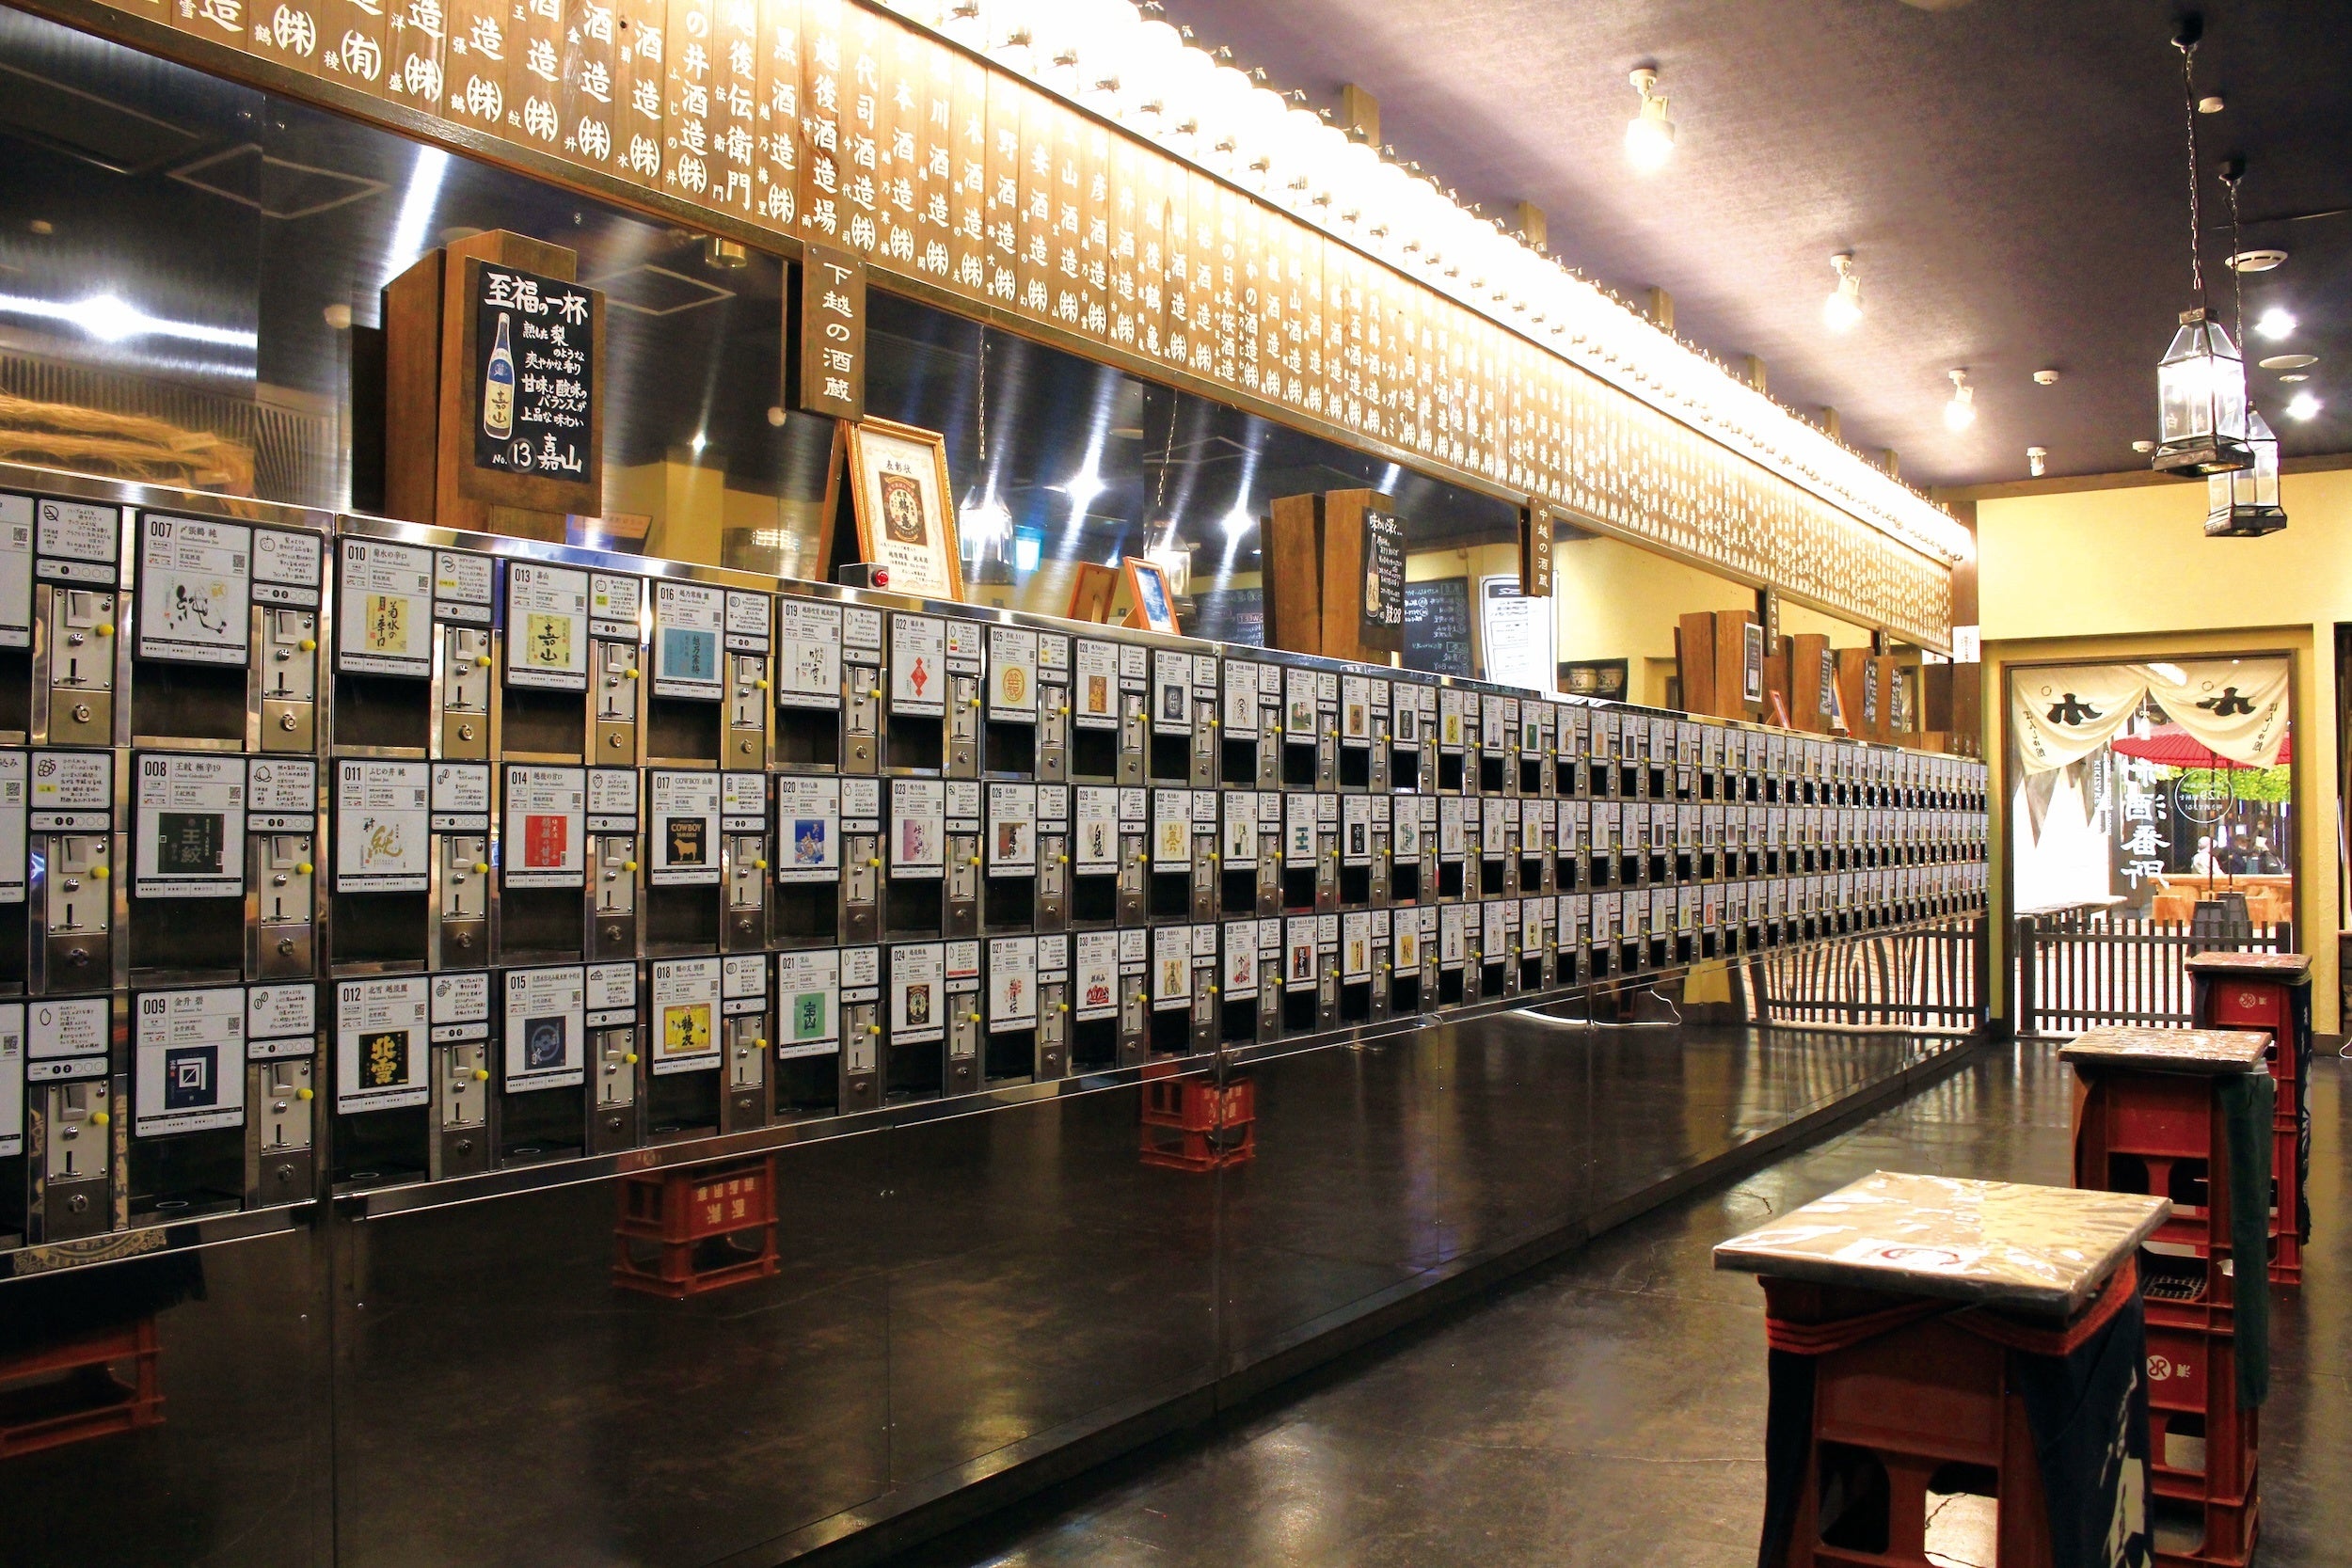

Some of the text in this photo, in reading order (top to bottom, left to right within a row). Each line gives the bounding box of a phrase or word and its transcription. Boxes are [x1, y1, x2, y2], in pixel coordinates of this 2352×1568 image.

[484, 272, 589, 325] 至福の一杯
[821, 262, 854, 403] 下越の酒蔵
[525, 350, 581, 375] 爽やかな香り
[553, 349, 585, 362] のような
[521, 372, 588, 399] 甘味と酸味の
[538, 394, 587, 413] バランスが
[520, 406, 584, 428] 上品な味わい
[492, 442, 532, 467] No. 13
[537, 432, 582, 473] 嘉山
[886, 460, 912, 474] 表彰状
[151, 521, 172, 538] 007
[348, 546, 366, 562] 010
[373, 548, 407, 560] 菊水の辛口
[1538, 508, 1549, 587] 中越の酒蔵
[515, 568, 531, 582] 013
[660, 588, 675, 601] 016
[786, 604, 798, 616] 019
[896, 618, 907, 630] 022
[538, 624, 560, 662] 嘉山
[993, 630, 1003, 642] 025
[145, 761, 167, 777] 008
[175, 762, 192, 771] 王紋
[369, 768, 395, 777] ふじの井
[345, 767, 361, 781] 011
[512, 771, 527, 784] 014
[657, 777, 670, 789] 017
[783, 781, 796, 793] 020
[895, 784, 906, 795] 023
[992, 787, 1002, 799] 026
[671, 824, 701, 832] COWBOY
[180, 827, 202, 864] 王紋
[894, 950, 905, 961] 024
[993, 943, 1002, 954] 027
[783, 958, 795, 969] 021
[657, 967, 671, 979] 018
[511, 975, 526, 990] 015
[343, 988, 361, 1002] 012
[368, 986, 383, 994] 北雪
[144, 999, 166, 1015] 009
[175, 997, 191, 1006] 金升
[371, 1035, 397, 1085] 北雪
